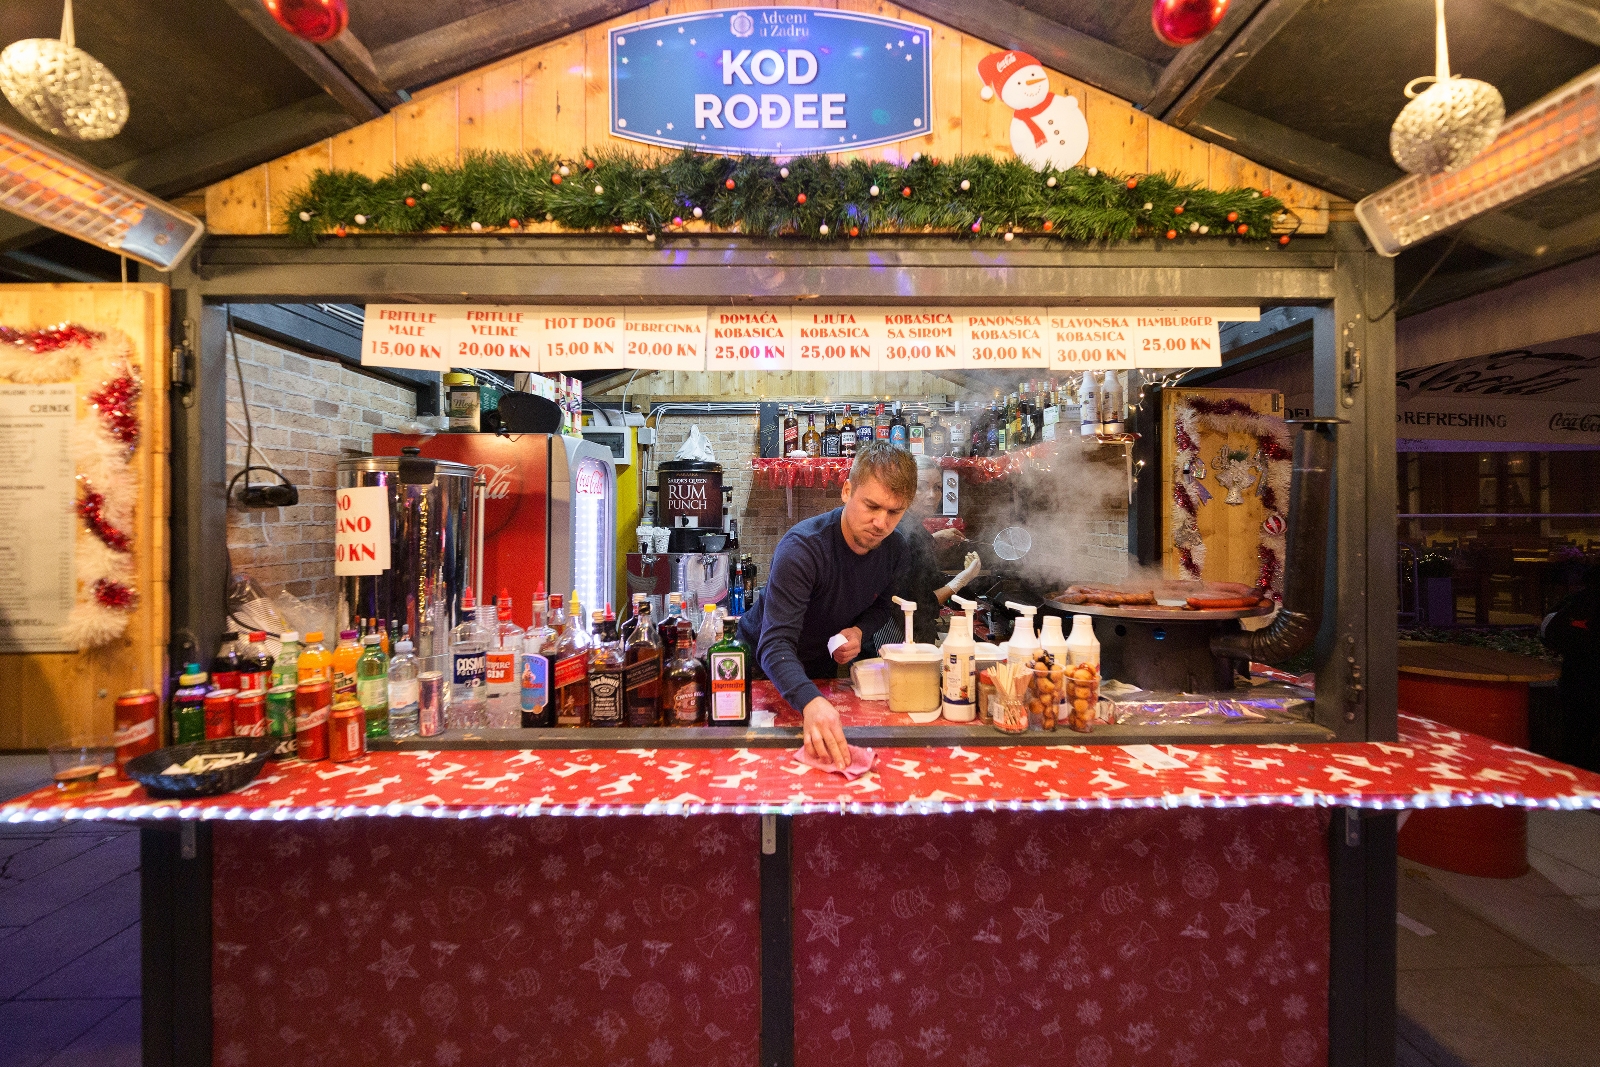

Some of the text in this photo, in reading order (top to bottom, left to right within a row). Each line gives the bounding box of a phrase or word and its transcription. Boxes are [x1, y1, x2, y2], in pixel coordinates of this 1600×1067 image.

[761, 11, 807, 25] Advent
[760, 25, 809, 37] u Zadru
[722, 49, 818, 85] KOD
[694, 93, 847, 129] ROĐEE
[379, 309, 437, 324] FRITULE
[466, 310, 524, 323] FRITULE
[720, 311, 778, 324] DOMAĆA
[813, 313, 856, 324] LJUTA
[884, 313, 953, 325] KOBASICA
[968, 315, 1041, 327] PANONSKA
[1051, 317, 1129, 328] SLAVONSKA
[1137, 316, 1212, 327] HAMBURGER
[544, 317, 616, 330] HOT DOG
[625, 321, 701, 333] DEBRECINKA
[388, 324, 425, 337] MALE
[471, 324, 518, 337] VELIKE
[714, 327, 784, 338] KOBASICA
[800, 327, 870, 338] KOBASICA
[887, 327, 952, 339] SA SIROM
[971, 329, 1040, 340] KOBASICA
[1056, 331, 1125, 342] KOBASICA
[371, 340, 441, 358] 15,00 KN
[458, 341, 530, 358] 20,00 KN
[547, 341, 614, 357] 15,00 KN
[628, 341, 697, 357] 20,00 KN
[1142, 337, 1211, 353] 25,00 KN
[715, 345, 785, 361] 25,00 KN
[800, 345, 870, 361] 25,00 KN
[886, 344, 956, 361] 30,00 KN
[972, 346, 1042, 362] 30,00 KN
[1057, 348, 1127, 364] 30,00 KN
[1404, 411, 1508, 428] REFRESHING
[669, 484, 707, 499] RUM
[668, 500, 707, 509] PUNCH
[349, 543, 375, 561] KN
